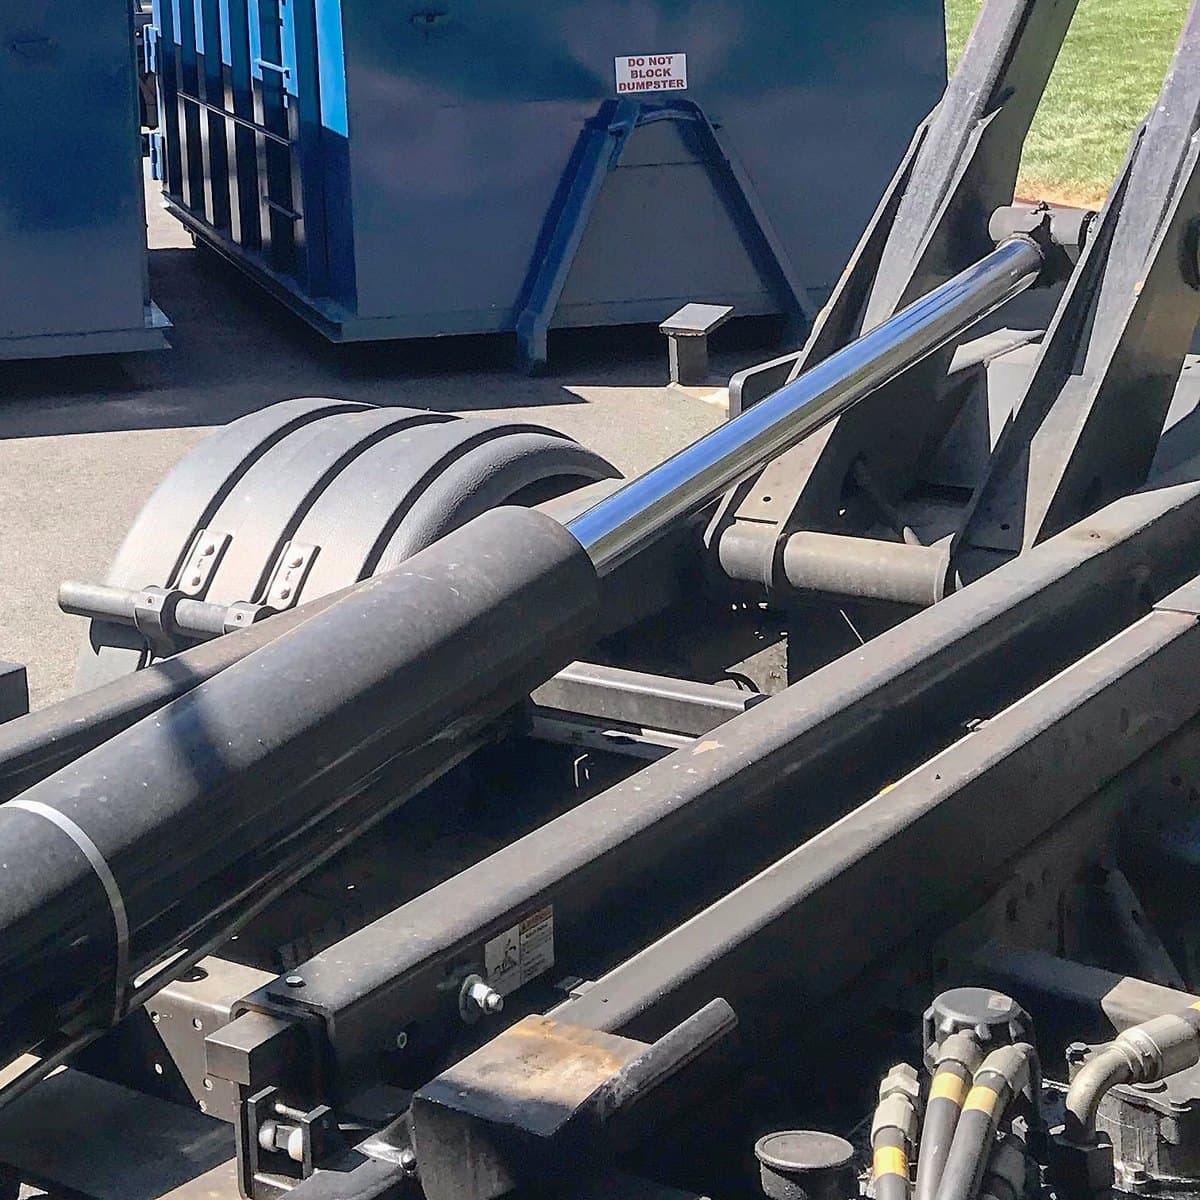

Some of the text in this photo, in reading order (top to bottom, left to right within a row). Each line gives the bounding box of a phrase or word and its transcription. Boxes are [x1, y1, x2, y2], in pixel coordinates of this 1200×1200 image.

[628, 56, 673, 67] DO NOT
[630, 68, 672, 79] BLOCK
[619, 79, 685, 91] DUMPSTER
